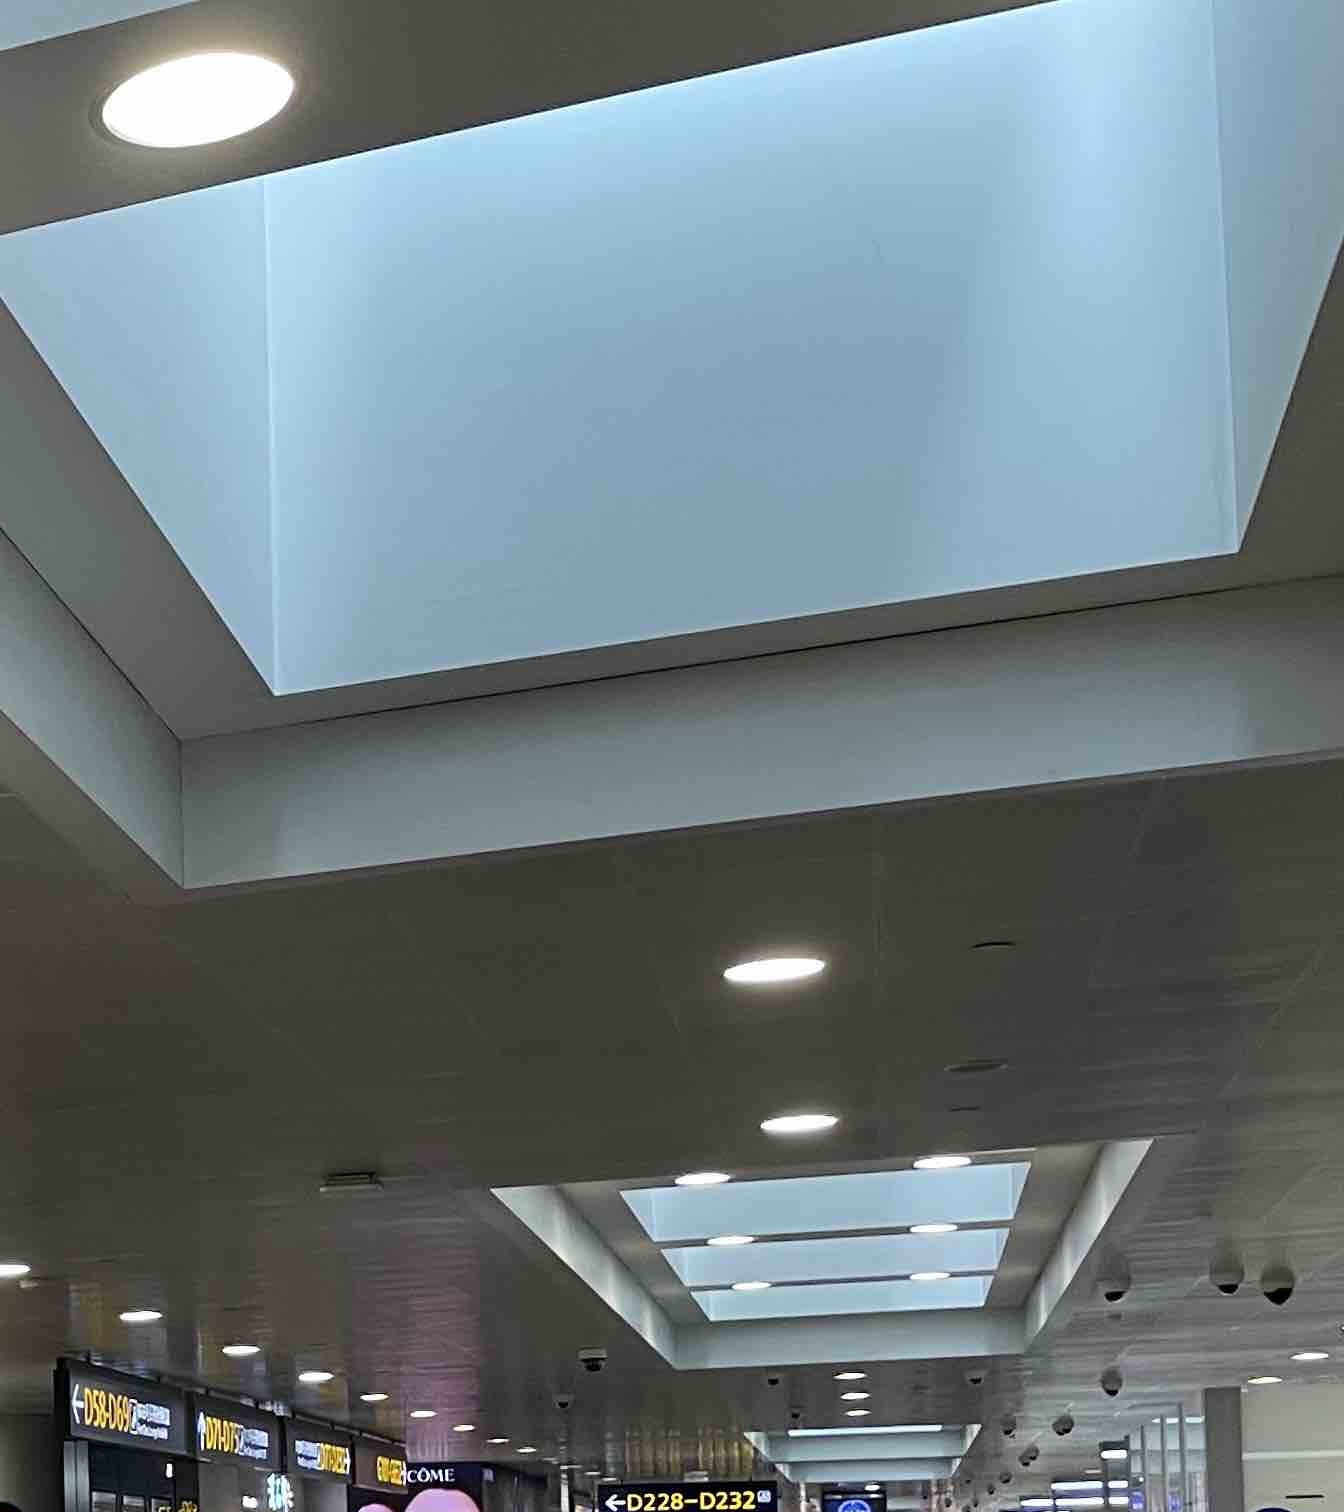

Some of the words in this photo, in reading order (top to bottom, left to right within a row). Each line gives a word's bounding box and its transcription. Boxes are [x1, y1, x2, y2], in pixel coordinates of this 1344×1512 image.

[84, 1387, 130, 1432] D58-D69
[405, 1466, 455, 1484] CÔME
[626, 1490, 756, 1512] D228-D232
